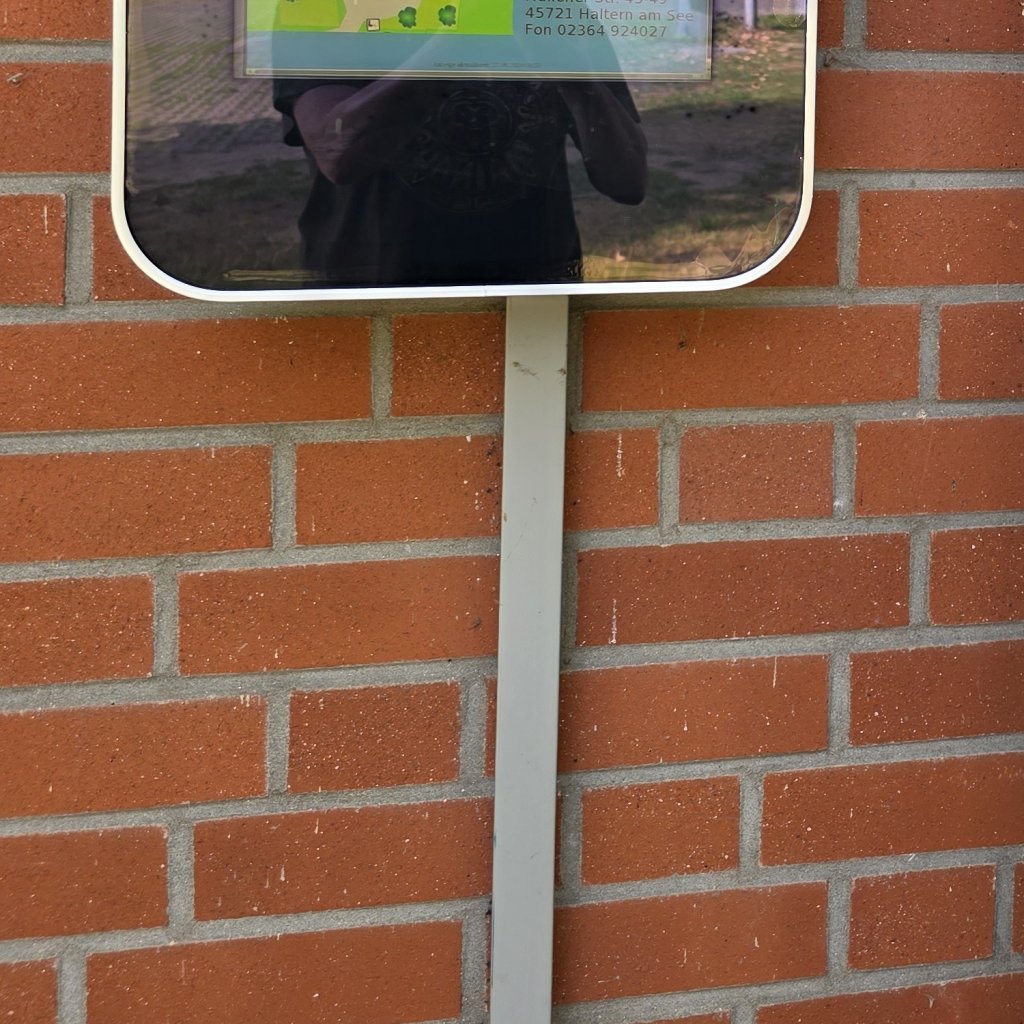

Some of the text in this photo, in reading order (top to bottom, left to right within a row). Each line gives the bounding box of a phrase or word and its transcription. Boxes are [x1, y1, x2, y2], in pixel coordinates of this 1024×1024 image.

[525, 7, 694, 21] 45721 Haltern am See
[525, 23, 667, 37] Fon 02364 924027
